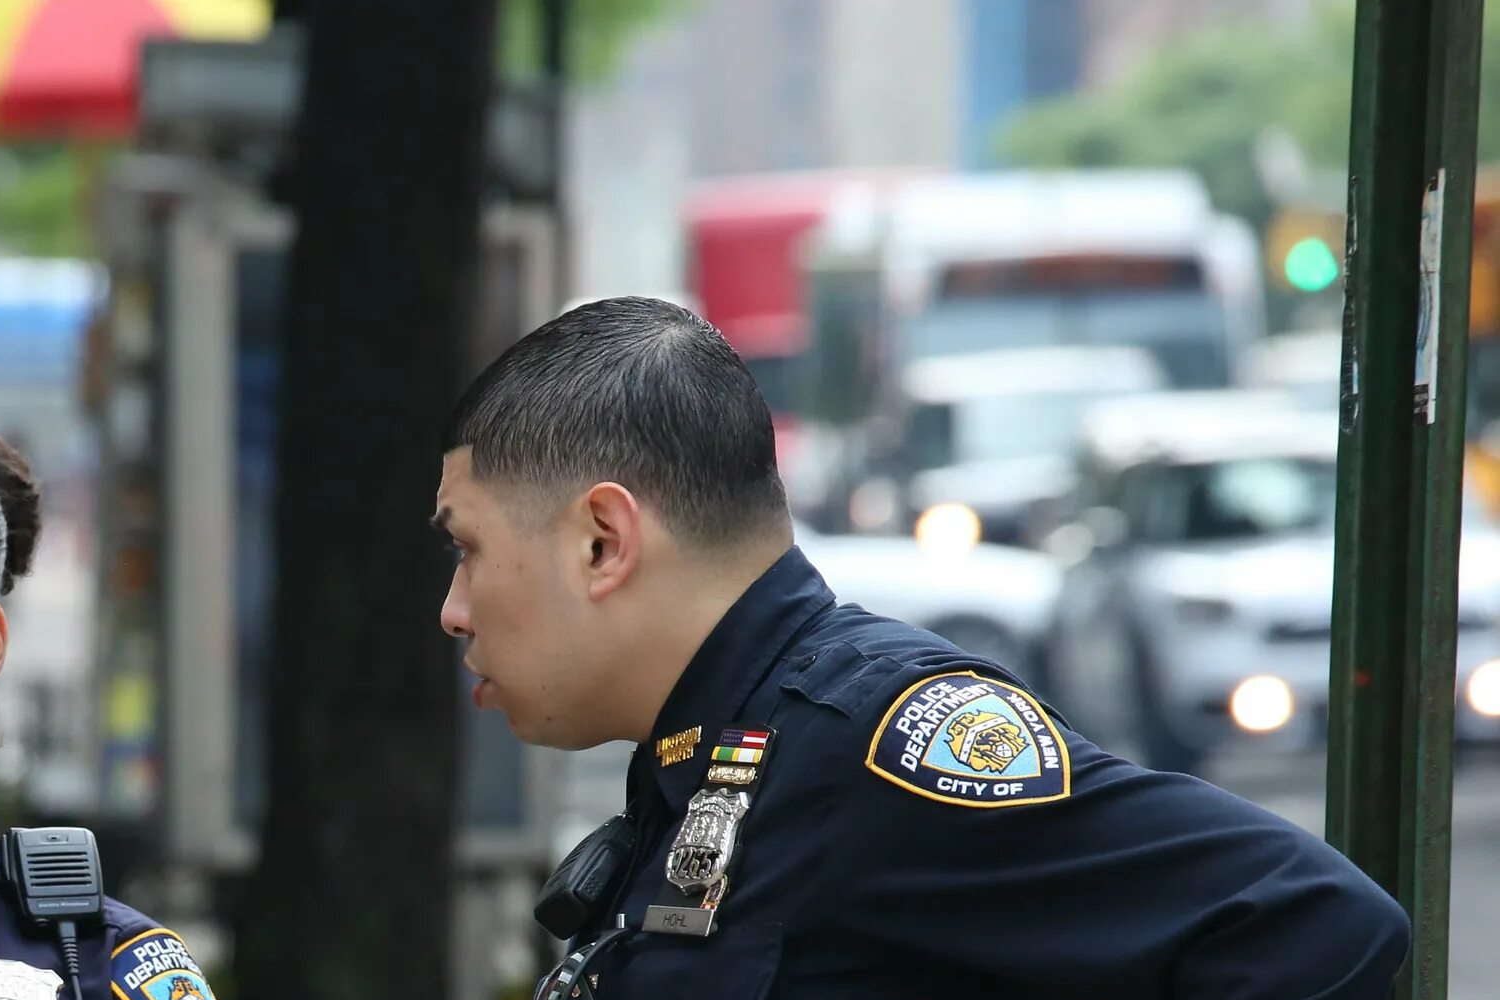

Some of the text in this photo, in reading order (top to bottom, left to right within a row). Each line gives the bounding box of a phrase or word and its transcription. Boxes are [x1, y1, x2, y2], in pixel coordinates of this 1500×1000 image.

[895, 681, 959, 735] POLICE
[900, 682, 996, 773] DEPARTMENT
[936, 692, 1059, 796] CITY OF NEW YORK
[663, 912, 687, 928] HOHL
